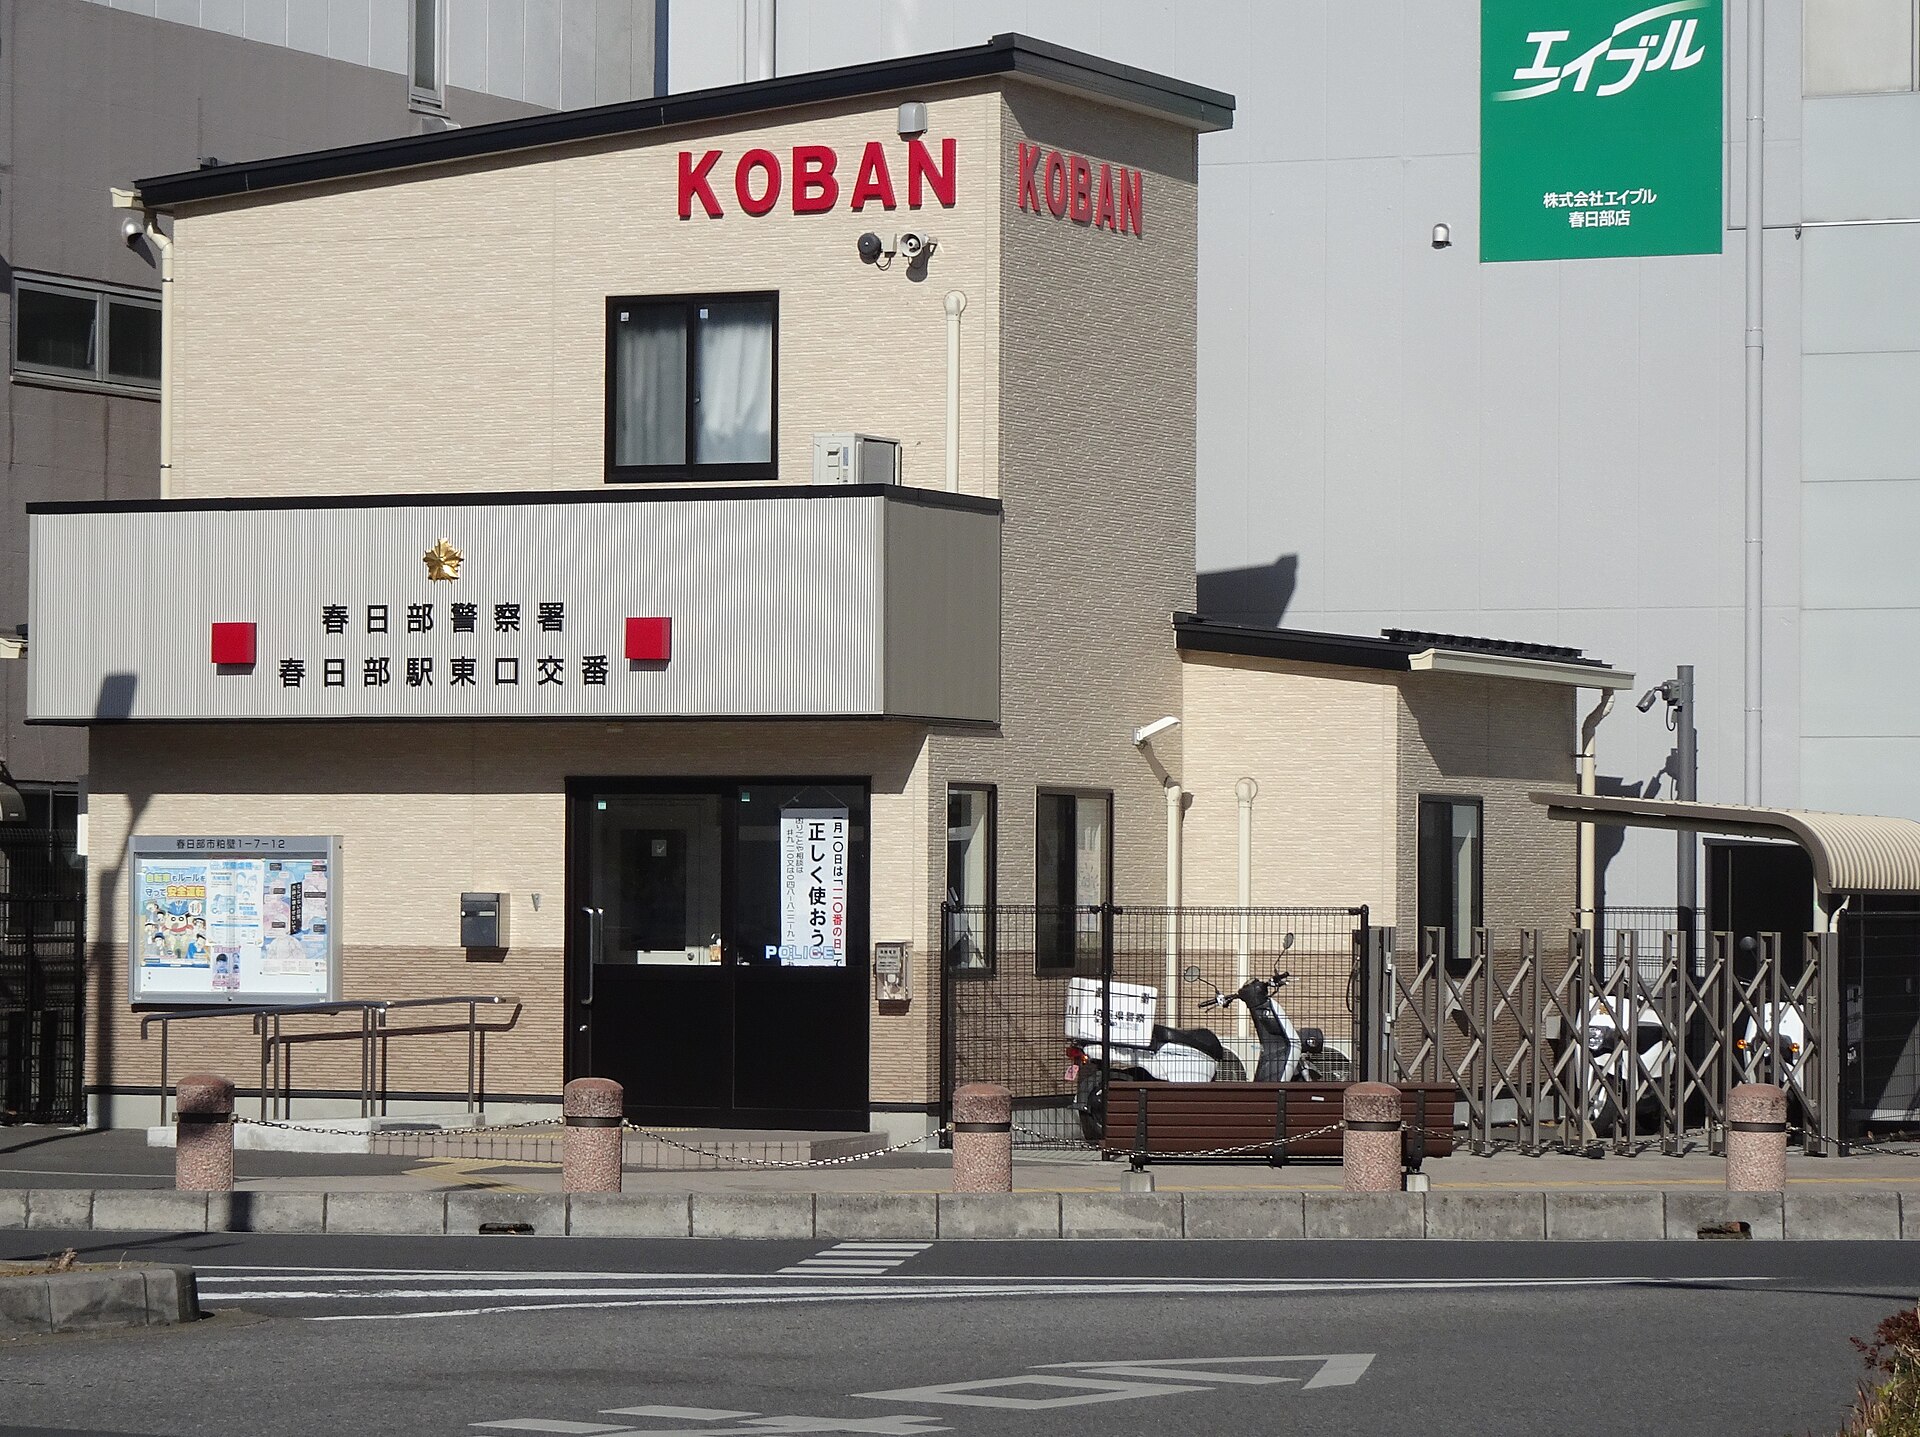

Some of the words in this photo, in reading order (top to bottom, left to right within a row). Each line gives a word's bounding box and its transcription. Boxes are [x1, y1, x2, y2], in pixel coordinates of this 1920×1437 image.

[1511, 17, 1706, 97] エイブル
[678, 137, 957, 220] KOBAN
[1018, 141, 1143, 236] KOBAN
[1542, 187, 1657, 209] 株式会社エイブル
[1568, 209, 1631, 228] 春日部店
[321, 601, 566, 635] 春日部警察署
[278, 654, 610, 689] 春日部駅東口交番
[765, 945, 836, 960] POLICE
